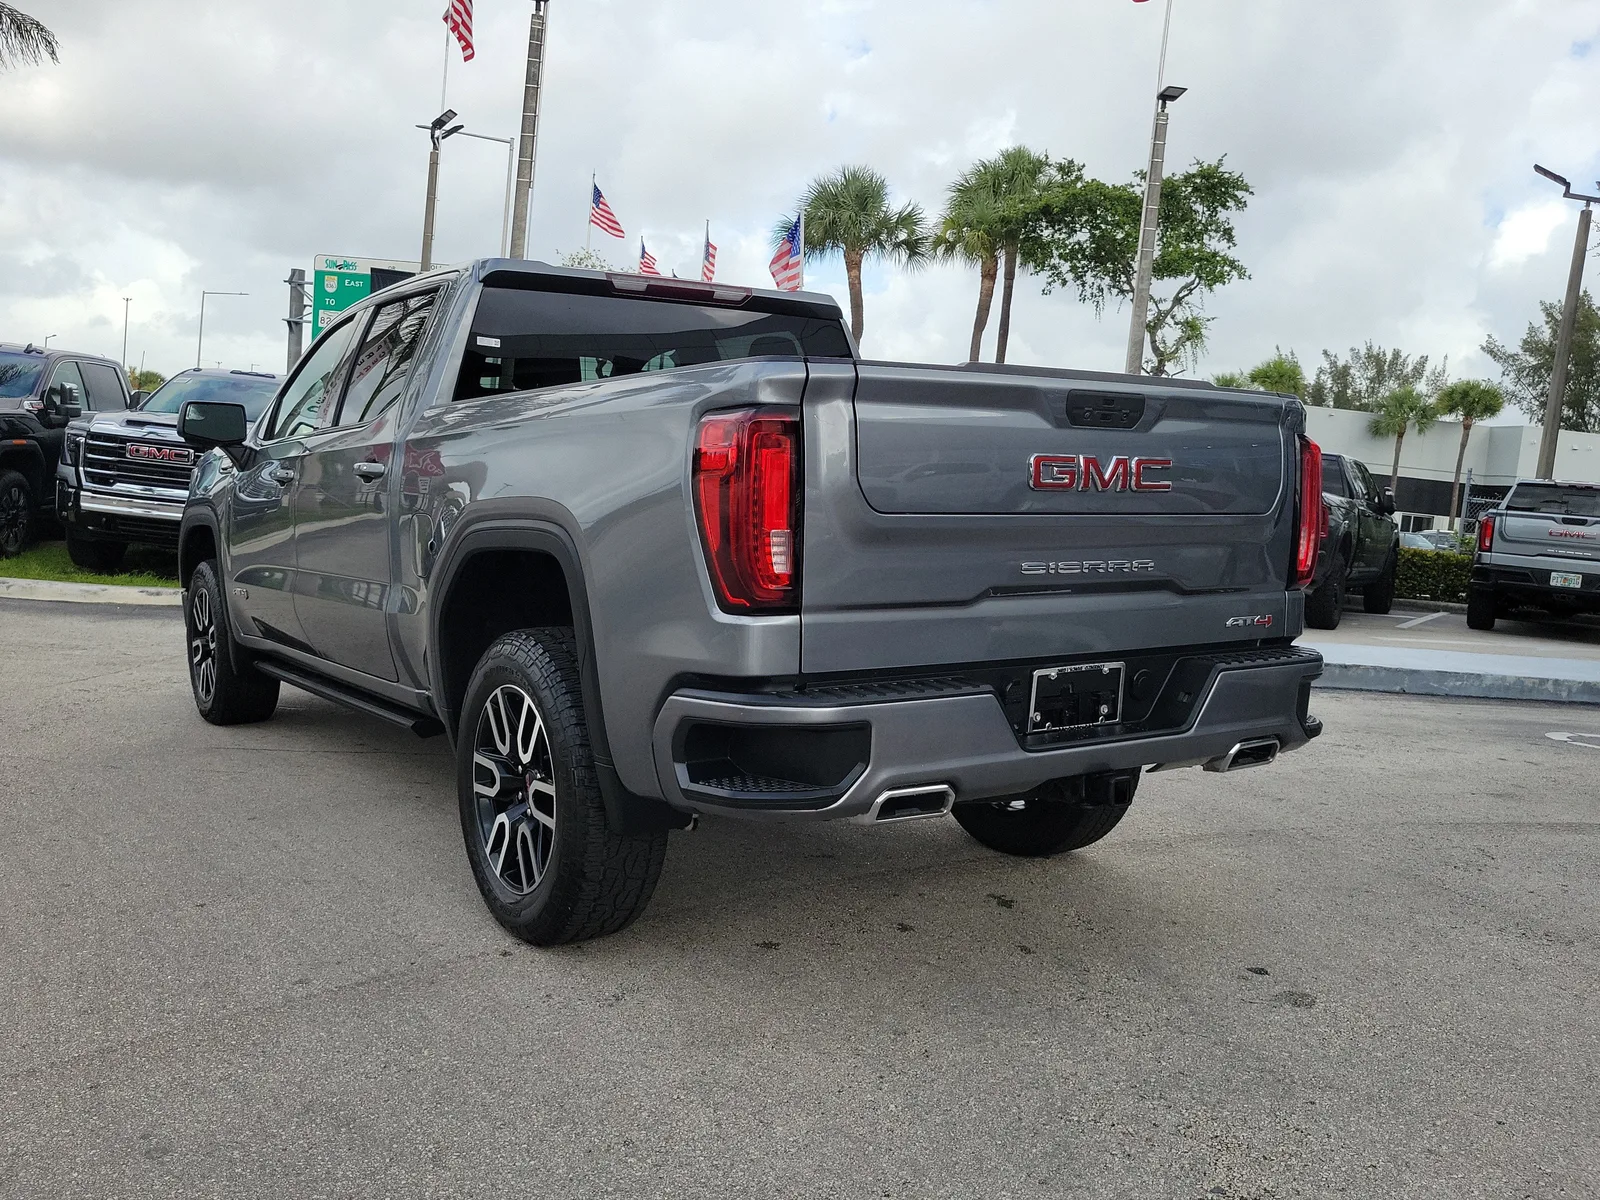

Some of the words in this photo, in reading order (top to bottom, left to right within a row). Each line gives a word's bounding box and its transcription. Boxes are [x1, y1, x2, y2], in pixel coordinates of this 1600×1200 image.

[345, 279, 364, 288] EAST
[325, 298, 336, 306] TO
[130, 445, 189, 461] GMC
[1028, 453, 1173, 492] GMC
[1549, 529, 1596, 539] GMC
[1020, 559, 1155, 575] SIERRA
[1225, 614, 1272, 628] AT4
